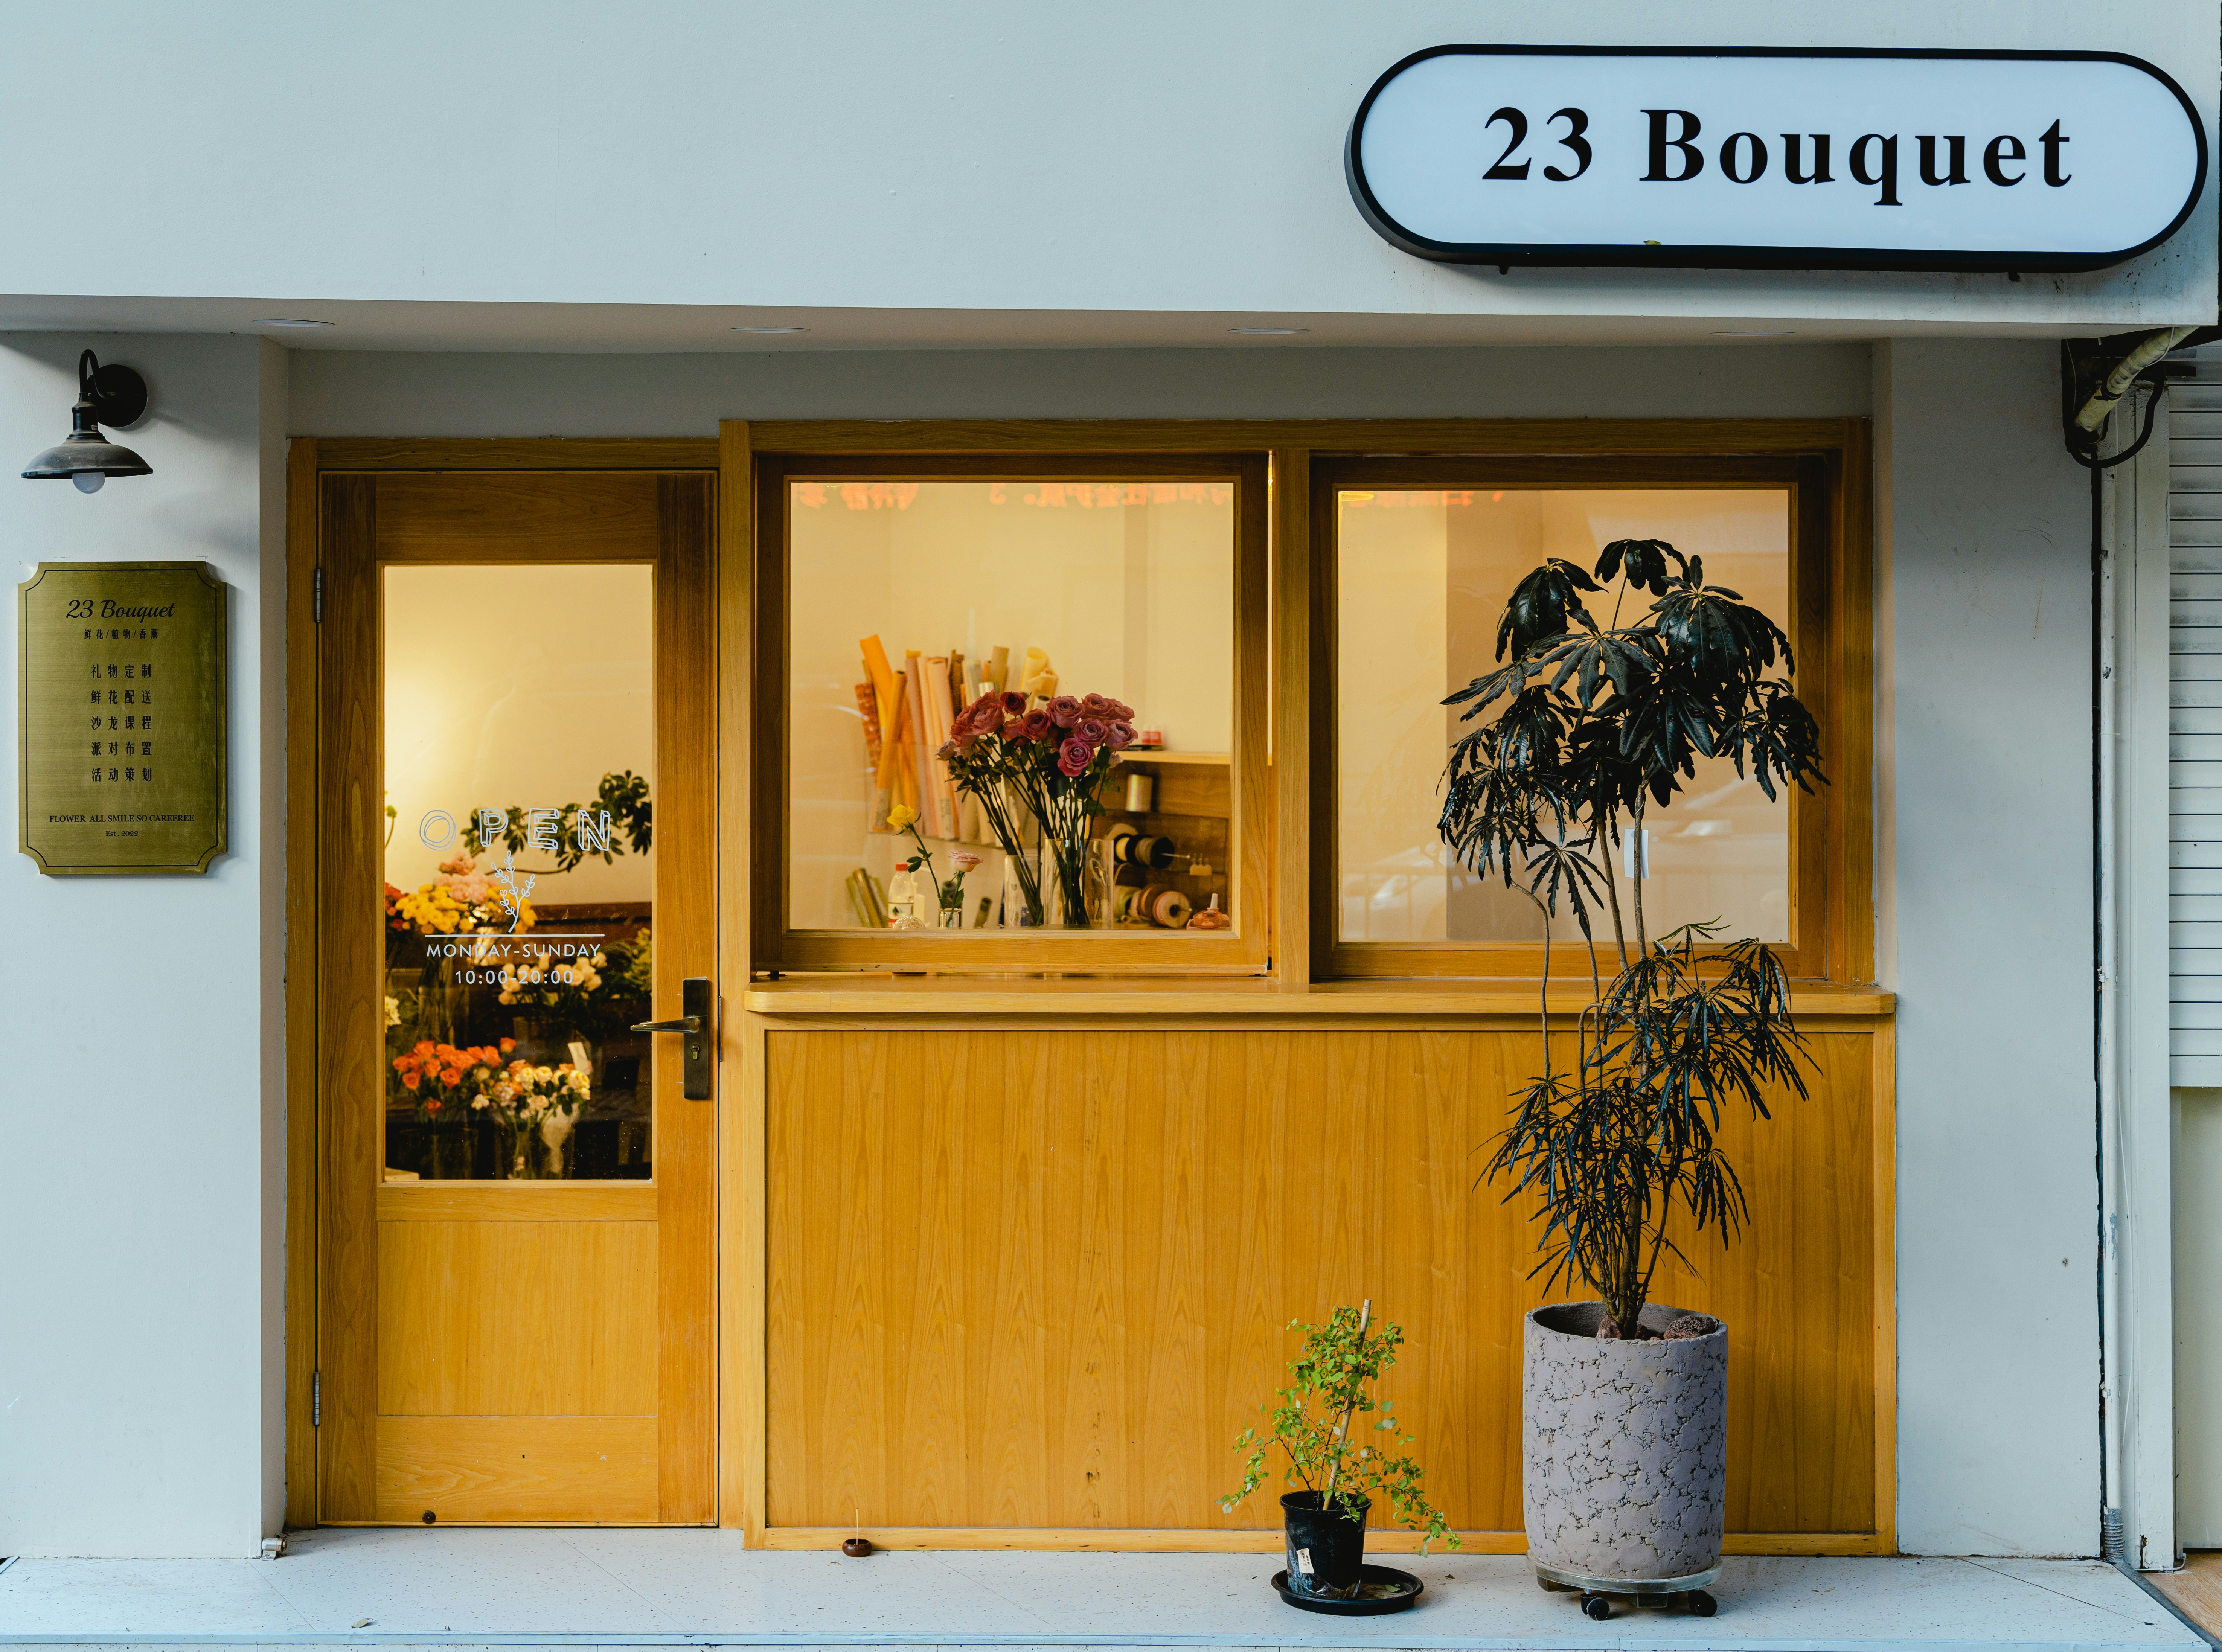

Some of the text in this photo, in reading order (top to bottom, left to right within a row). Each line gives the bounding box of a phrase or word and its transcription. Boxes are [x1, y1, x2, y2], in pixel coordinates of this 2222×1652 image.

[1482, 107, 2072, 206] 23 Bouquet
[66, 600, 175, 623] 23 Bouquet
[91, 664, 151, 678] 礼物定制
[91, 690, 151, 704] 鲜花配送
[91, 715, 151, 730] 沙龙课程
[91, 741, 152, 756] 派对布置
[91, 767, 152, 782] 活动策划
[419, 807, 611, 852] OPEN
[426, 943, 601, 958] MONDAY-SUNDAY
[456, 970, 573, 984] 10:00-20:00
